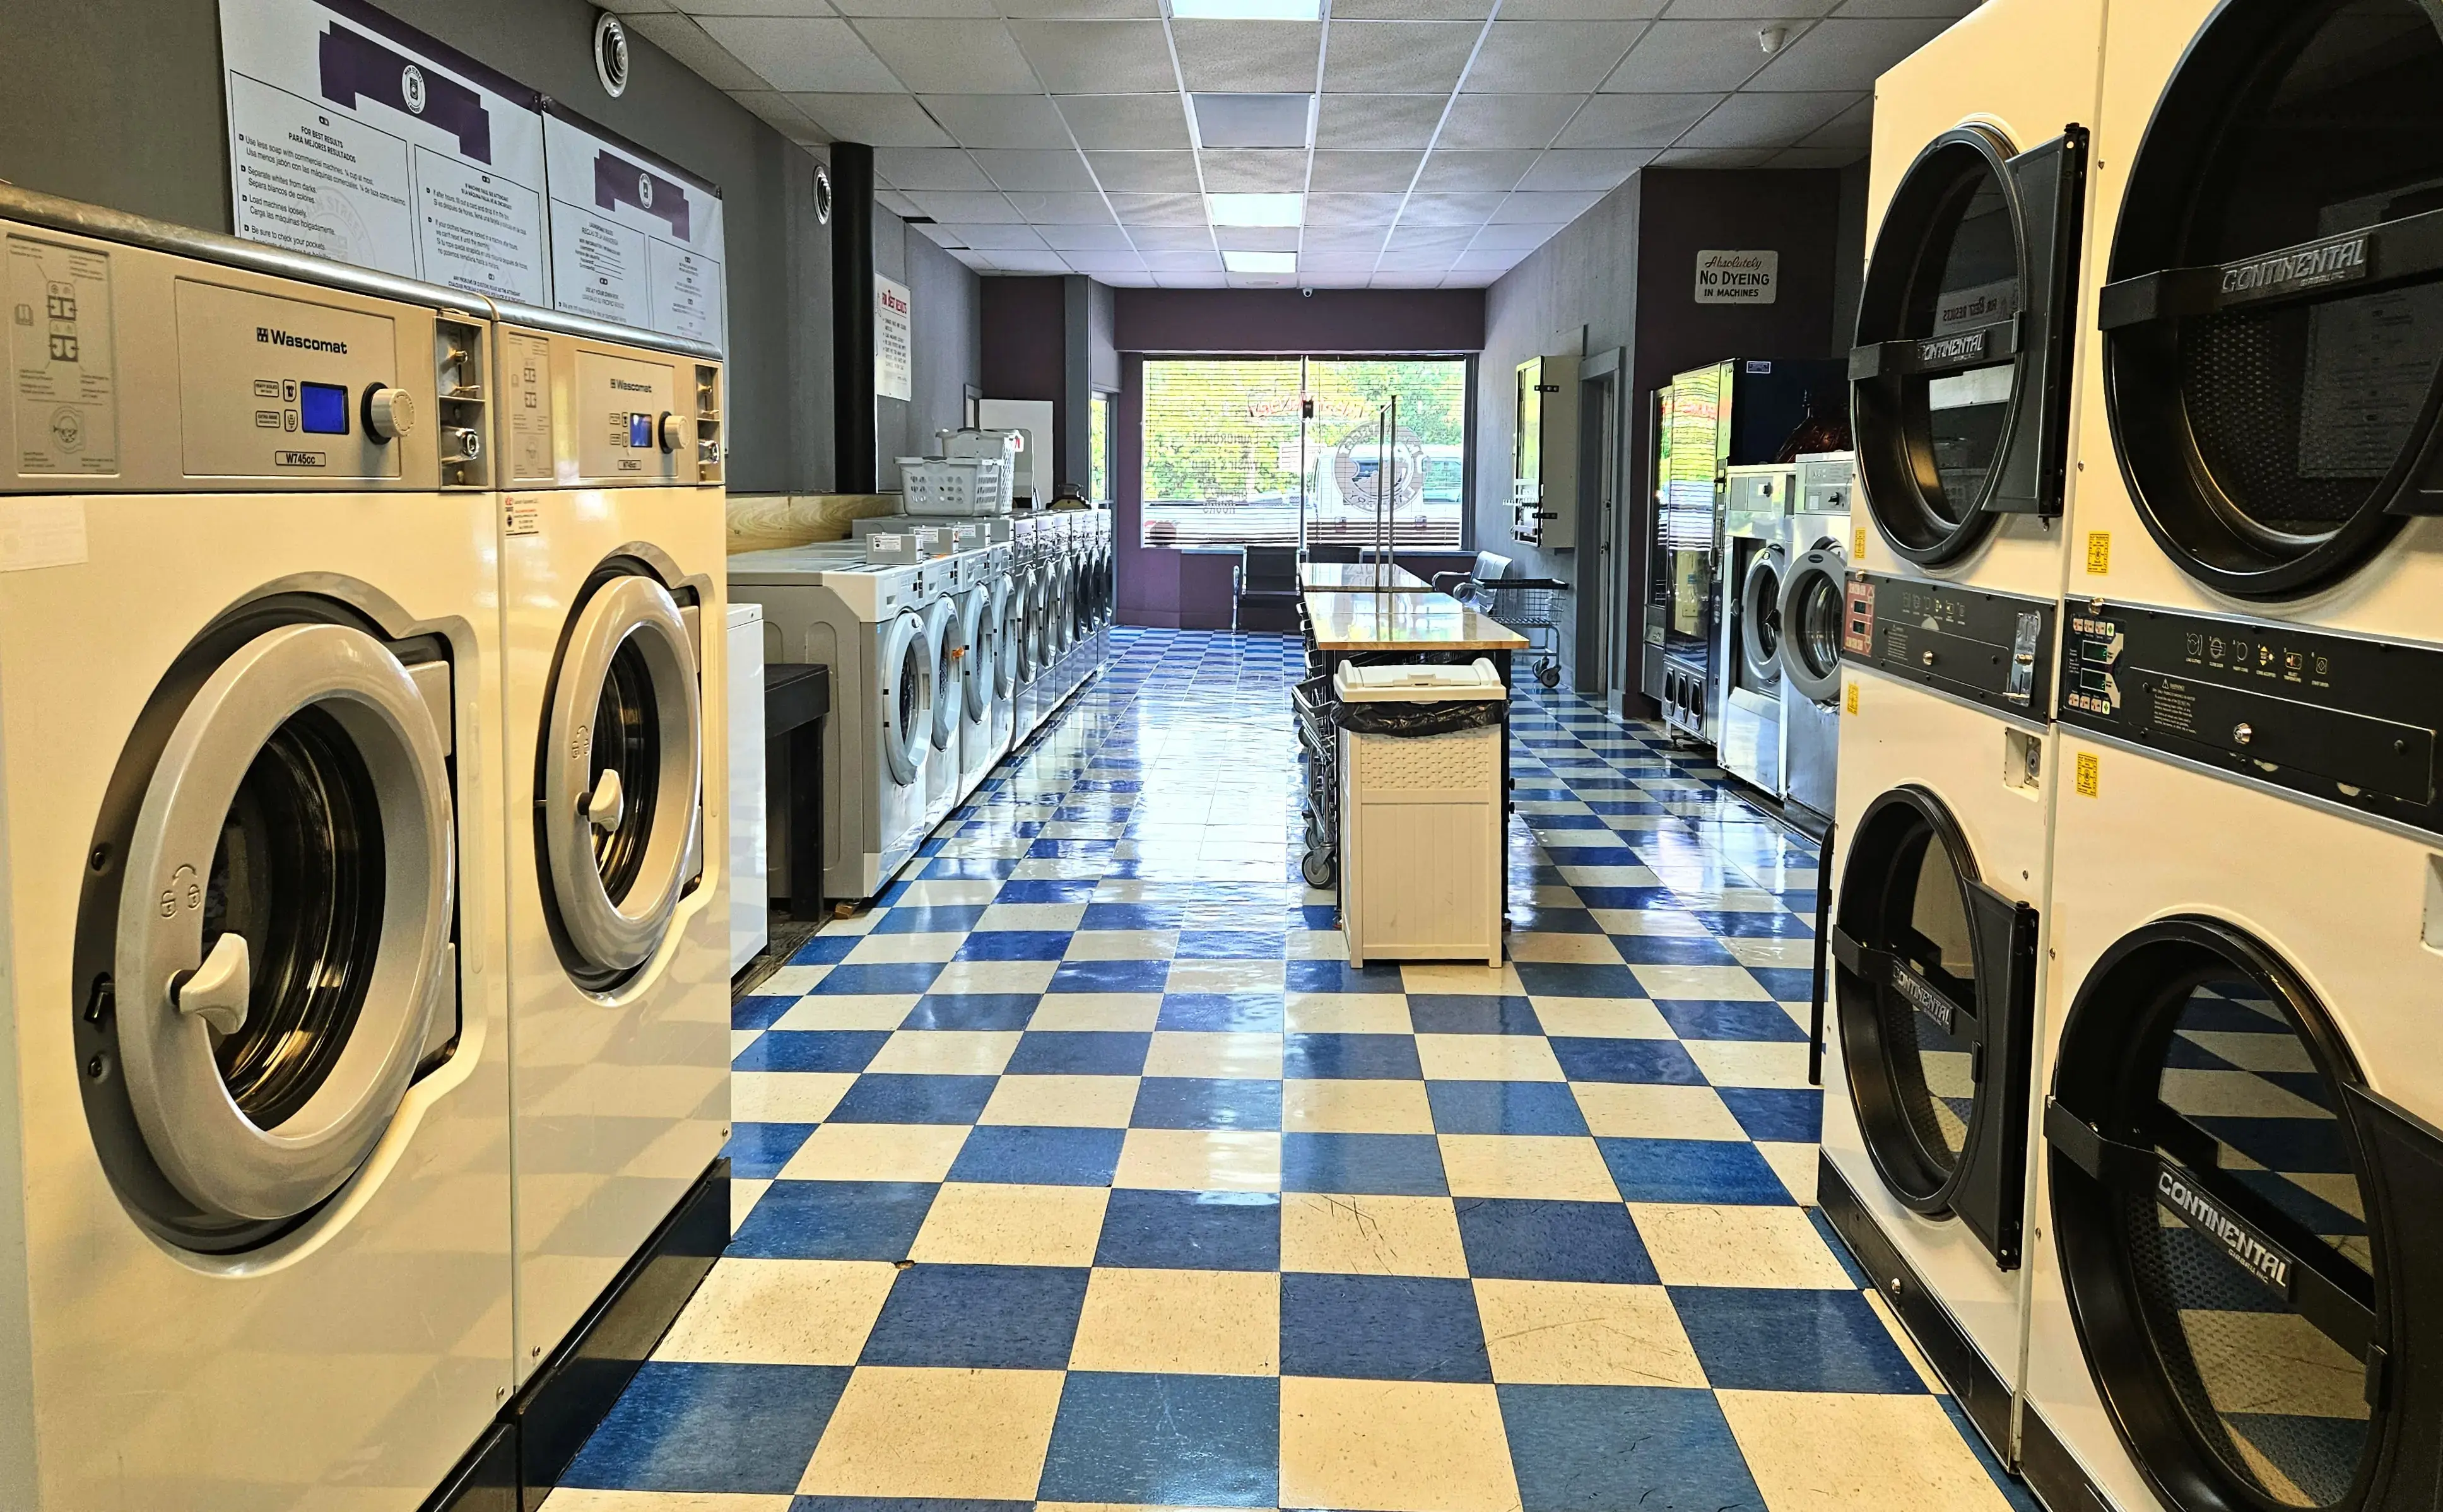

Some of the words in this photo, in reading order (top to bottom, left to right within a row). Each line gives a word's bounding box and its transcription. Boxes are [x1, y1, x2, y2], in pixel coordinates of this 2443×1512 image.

[245, 136, 256, 146] Use
[257, 140, 268, 150] less
[269, 145, 281, 155] soap
[283, 149, 294, 158] with
[289, 132, 303, 144] PARA
[304, 138, 327, 153] MEJORES
[327, 146, 356, 163] RESULTADOS
[302, 126, 311, 136] FOR
[312, 130, 324, 139] BEST
[324, 135, 343, 148] RESULTS
[246, 146, 257, 158] Usa
[257, 152, 275, 164] menos
[291, 163, 302, 172] con
[247, 165, 271, 180] Separate
[271, 175, 288, 185] whites
[289, 179, 302, 189] from
[249, 177, 266, 190] Separa
[268, 184, 288, 196] blancos
[249, 194, 262, 206] Load
[263, 200, 288, 213] machines
[250, 206, 266, 218] Carga
[275, 214, 300, 226] máquinas
[251, 225, 259, 235] Be
[260, 228, 271, 238] sure
[278, 233, 292, 242] check
[293, 237, 305, 245] your
[1705, 256, 1762, 270] Absolutely
[2221, 240, 2364, 291] CONTINENTAL
[271, 329, 348, 355] Wascomat
[616, 380, 652, 392] Wascomat
[286, 453, 315, 464] W745cc
[1893, 965, 1950, 1025] CONTINENTAL
[2158, 1171, 2287, 1287] CONTINENTAL
